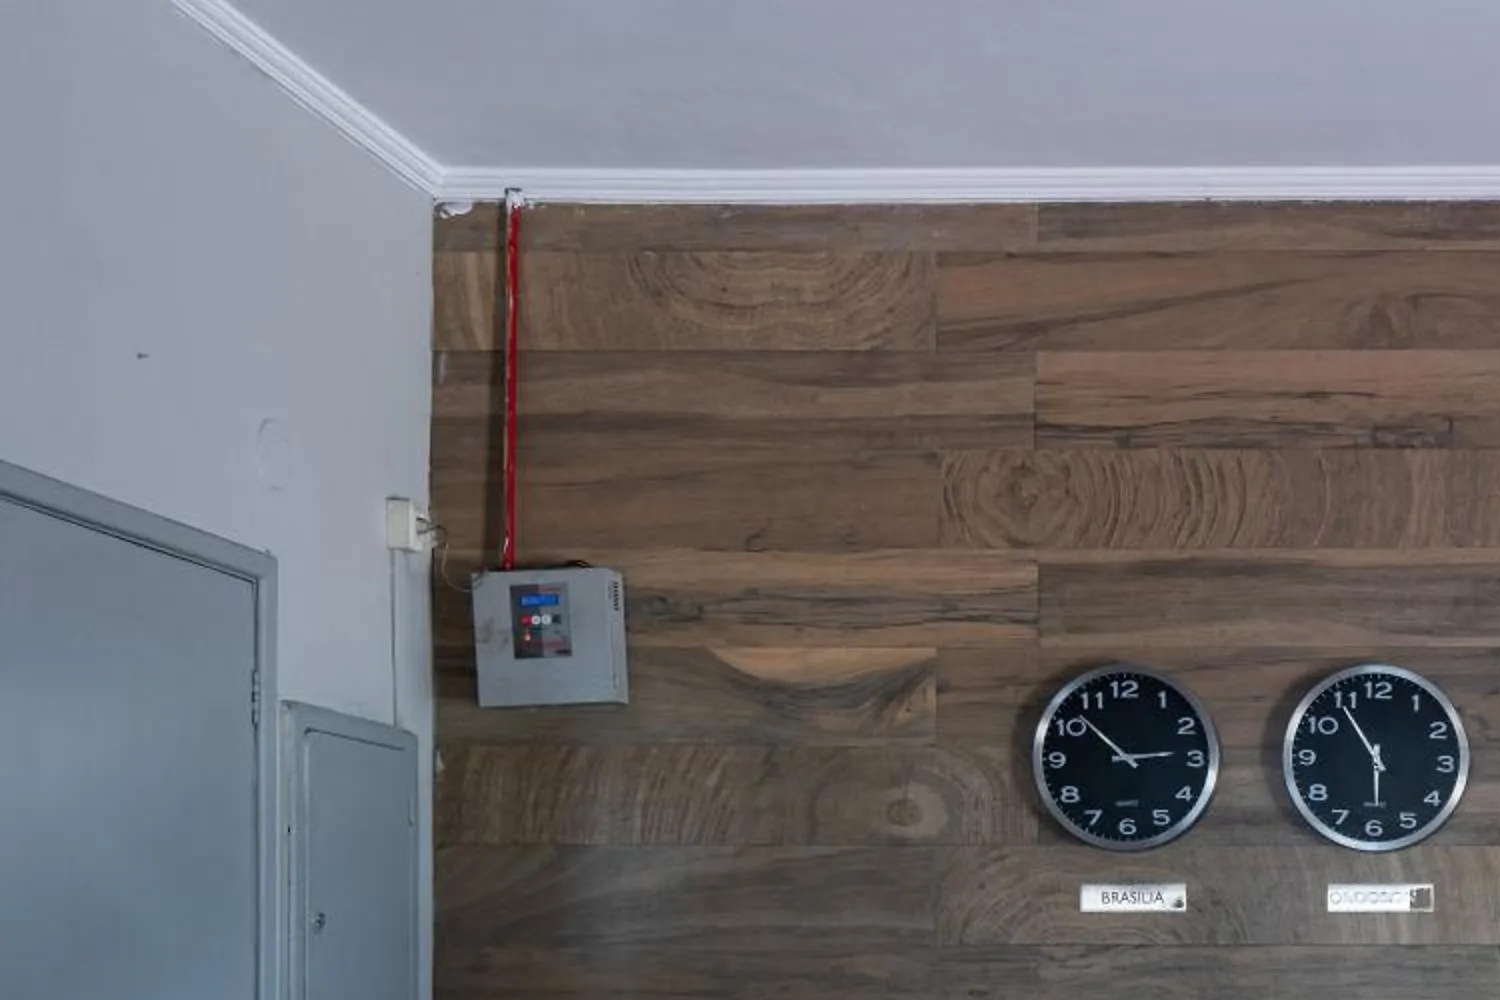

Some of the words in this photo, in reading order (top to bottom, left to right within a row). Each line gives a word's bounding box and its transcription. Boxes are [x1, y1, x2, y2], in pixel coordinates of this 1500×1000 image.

[1110, 679, 1140, 699] 12
[1364, 681, 1393, 700] 12
[1081, 691, 1104, 709] 11
[1158, 691, 1167, 709] 1
[1333, 691, 1357, 709] 11
[1411, 694, 1420, 713] 1
[1056, 718, 1087, 737] 10
[1177, 716, 1197, 736] 2
[1308, 716, 1339, 735] 10
[1428, 721, 1449, 740] 2
[1049, 751, 1067, 769] 9
[1185, 750, 1204, 768] 3
[1298, 749, 1317, 766] 9
[1436, 755, 1455, 773] 3
[1060, 785, 1080, 803] 8
[1175, 785, 1192, 801] 4
[1308, 783, 1328, 801] 8
[1423, 789, 1441, 807] 4
[1083, 809, 1102, 826] 7
[1152, 809, 1171, 826] 5
[1331, 809, 1350, 825] 7
[1399, 812, 1418, 829] 5
[1118, 818, 1137, 835] 6
[1364, 819, 1384, 837] 6
